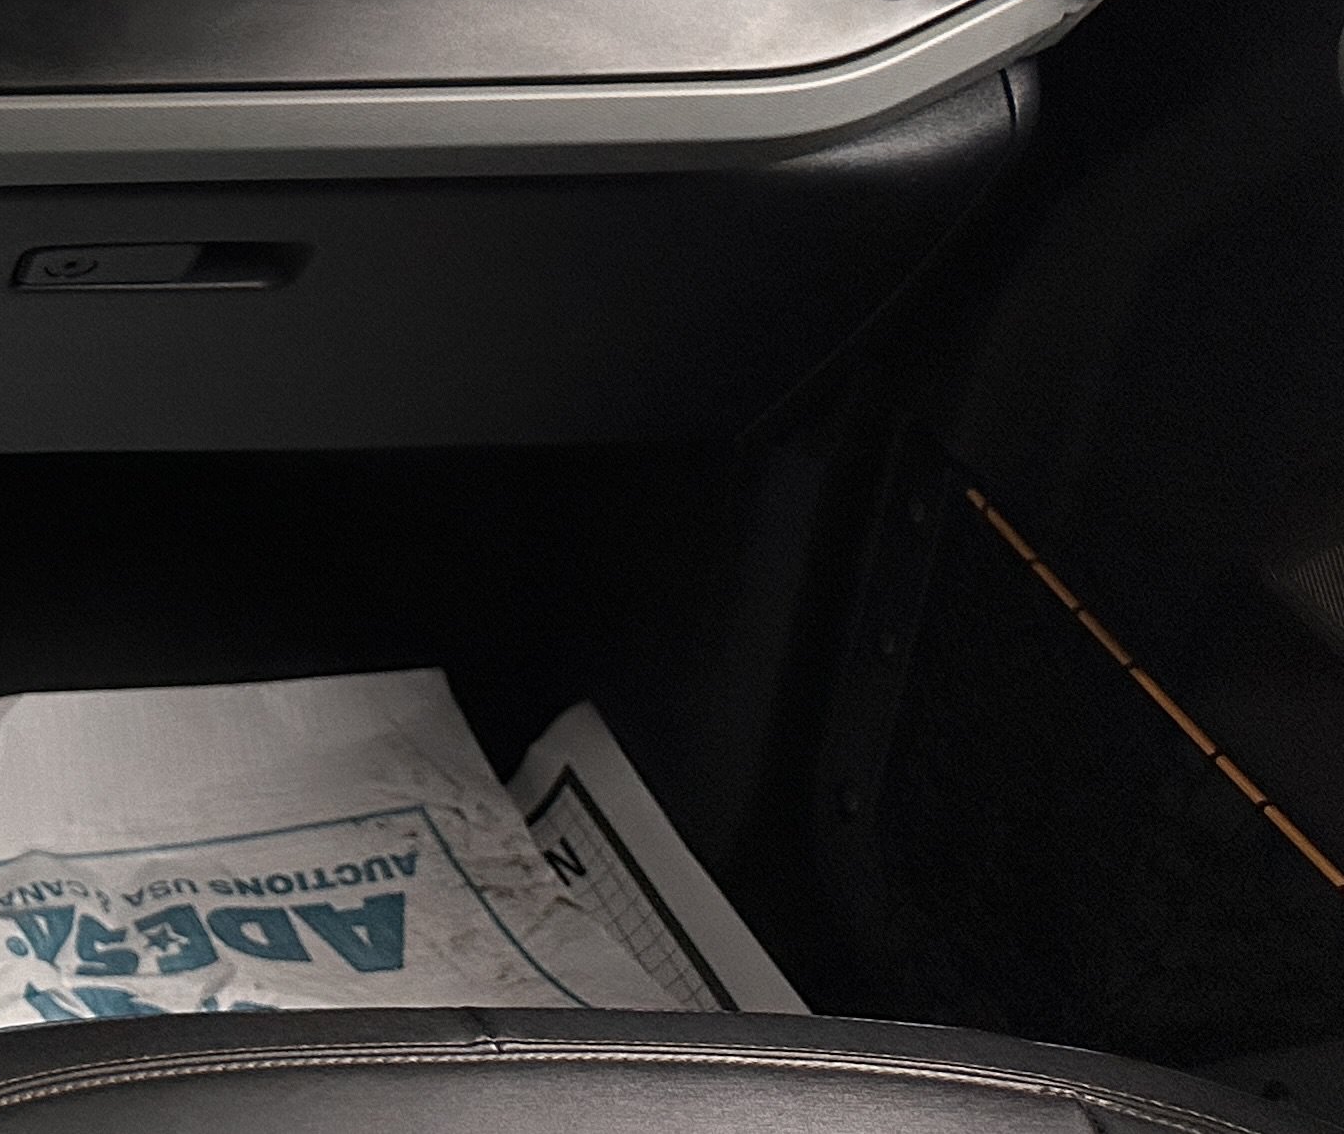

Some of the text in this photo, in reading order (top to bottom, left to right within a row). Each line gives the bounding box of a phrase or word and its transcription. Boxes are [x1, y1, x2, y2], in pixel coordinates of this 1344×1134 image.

[121, 876, 199, 907] USA
[208, 849, 419, 896] AUCTIONS
[11, 891, 406, 977] ADESA
